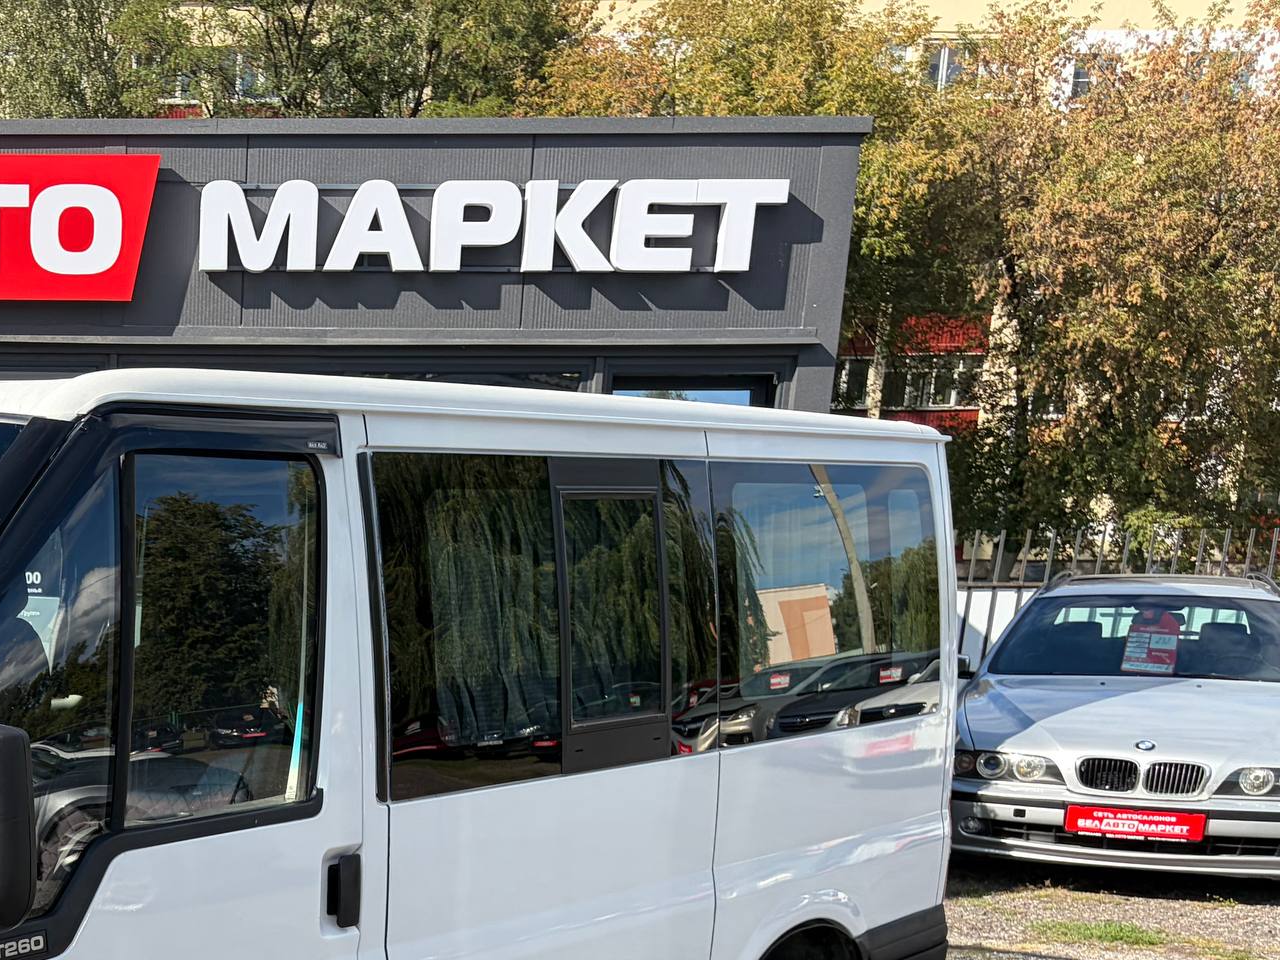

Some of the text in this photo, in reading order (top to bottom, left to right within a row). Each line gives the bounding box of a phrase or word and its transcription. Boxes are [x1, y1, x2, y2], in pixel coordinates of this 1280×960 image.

[198, 178, 791, 273] МАРКЕТ
[1093, 810, 1176, 822] СЕТЬ АВТОСАЛОНОВ
[1077, 818, 1190, 833] БЕЛ АВТО МАРКЕТ
